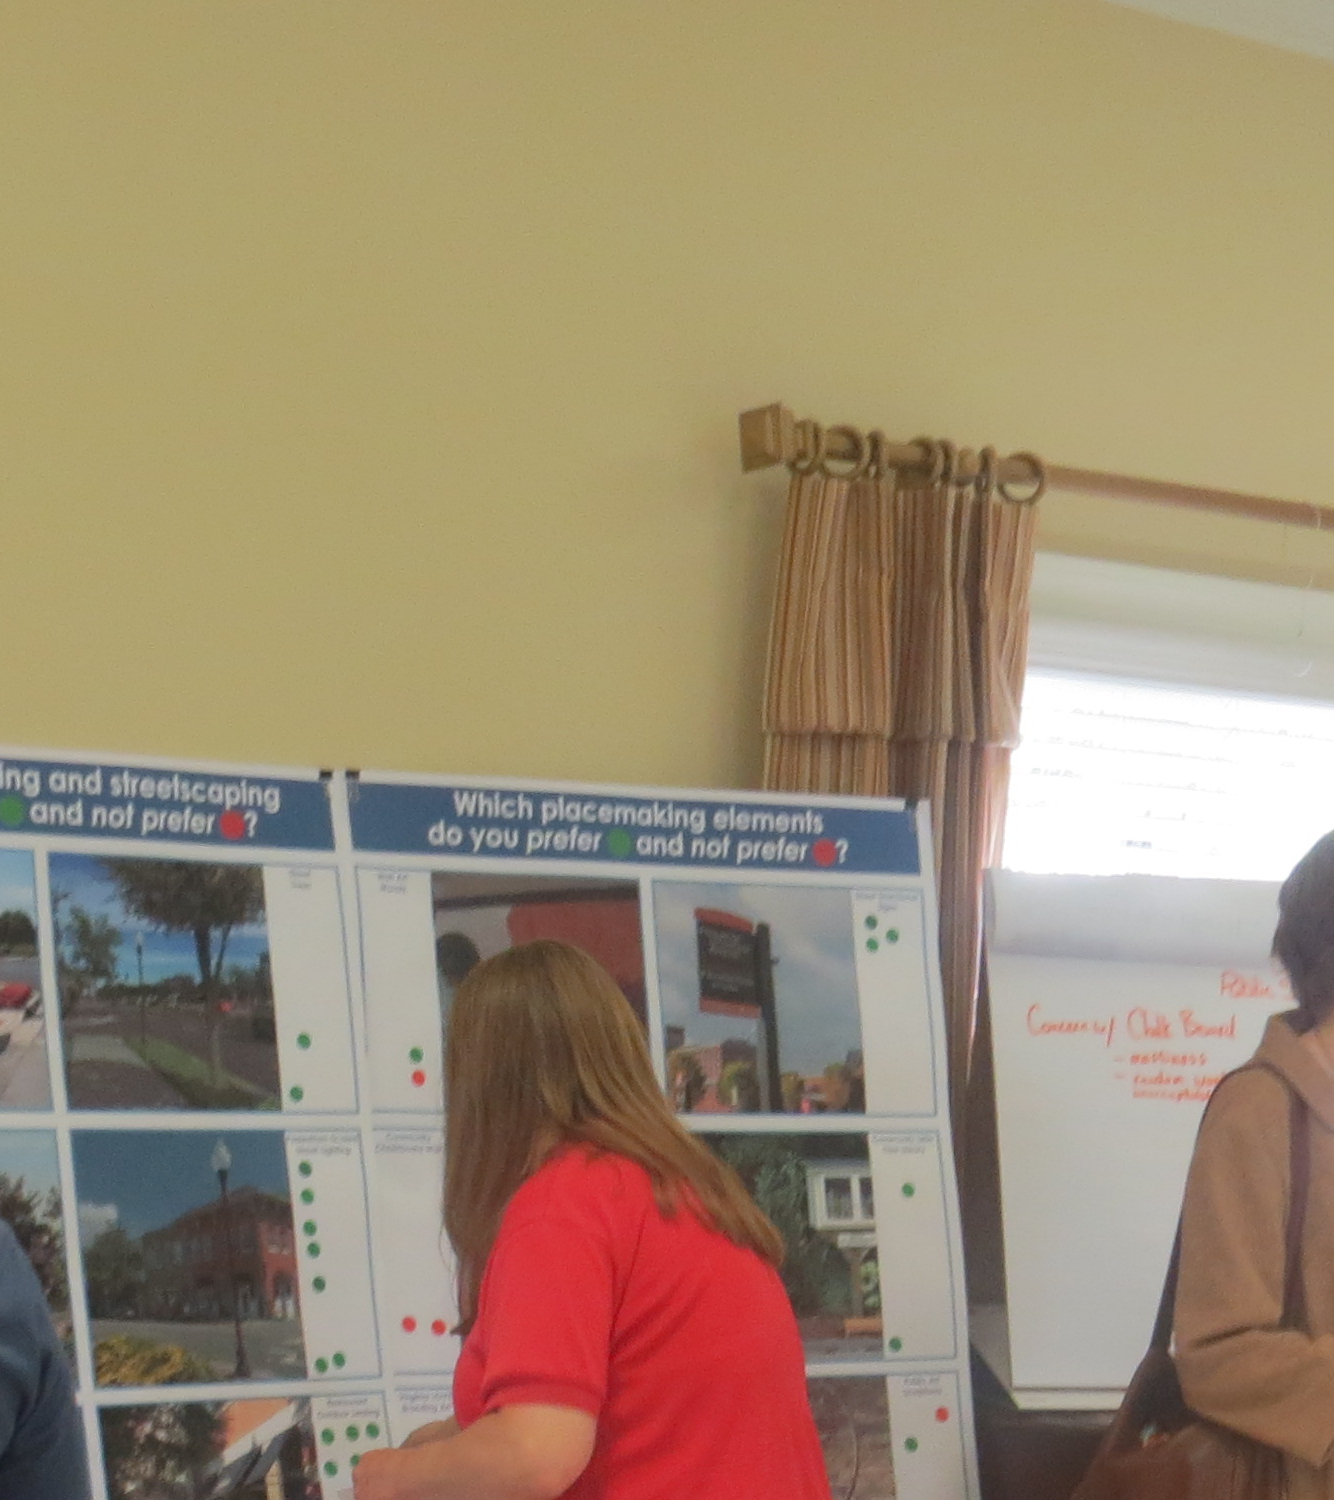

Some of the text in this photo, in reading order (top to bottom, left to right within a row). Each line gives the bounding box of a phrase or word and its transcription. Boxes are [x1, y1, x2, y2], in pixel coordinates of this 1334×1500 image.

[49, 767, 103, 796] and
[110, 770, 281, 814] streetscaping
[453, 790, 824, 834] Which placemaking elements
[29, 799, 84, 827] and
[91, 803, 135, 829] not
[141, 806, 216, 836] prefer
[243, 810, 259, 838] ?
[427, 819, 850, 865] do you prefer and not prefer ?
